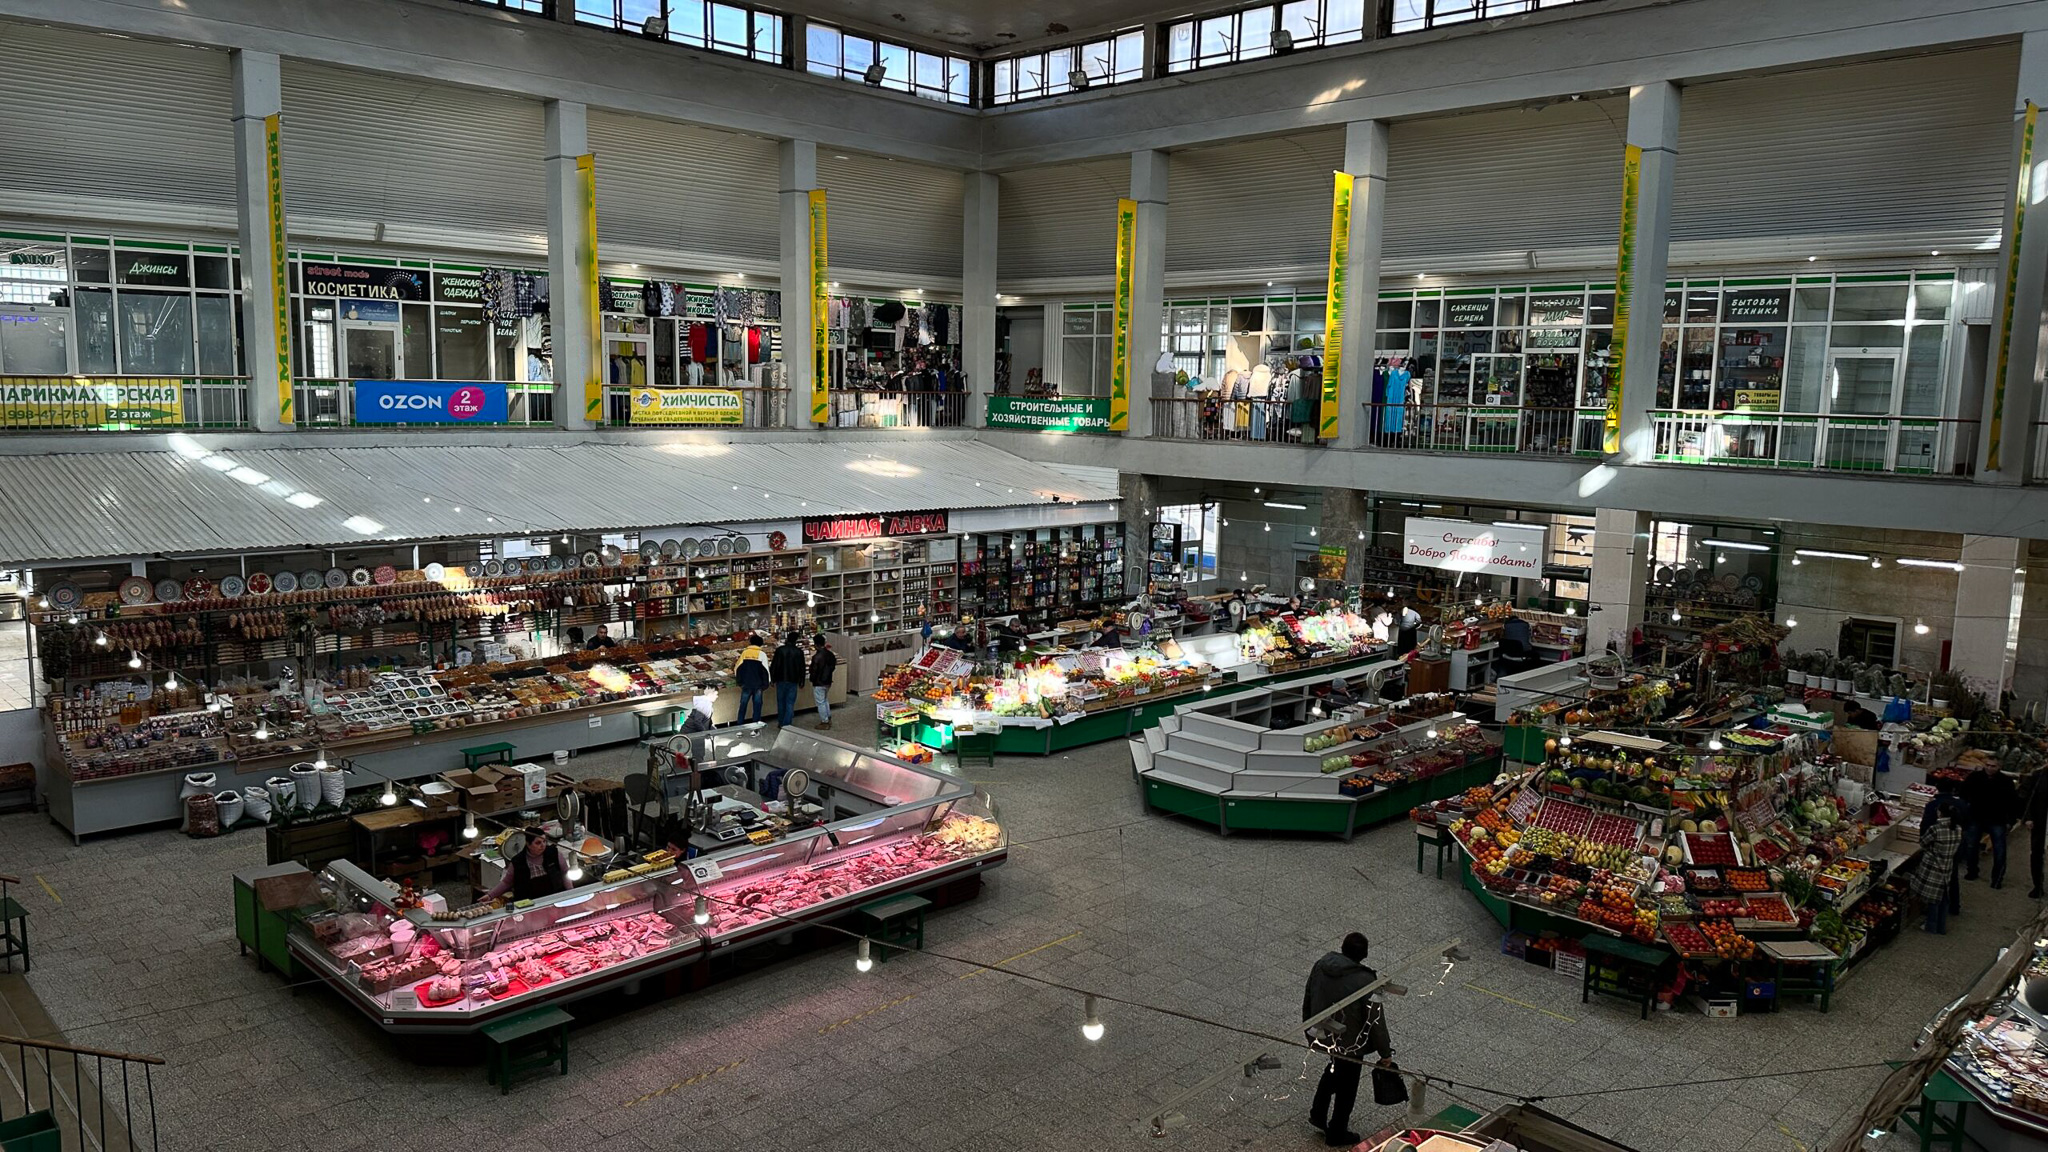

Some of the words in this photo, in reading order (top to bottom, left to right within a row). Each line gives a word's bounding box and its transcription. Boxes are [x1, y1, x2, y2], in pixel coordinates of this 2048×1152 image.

[268, 131, 289, 382] Мальцевский
[129, 262, 178, 275] Джинсы
[441, 277, 481, 287] ЖЕНСКАЯ
[308, 281, 399, 299] КОСМЕТИКА
[444, 288, 479, 298] ОДЕЖДА
[614, 300, 635, 308] БЕЛЬЕ
[686, 295, 714, 303] ЖИНСЫ
[1731, 298, 1780, 306] БЫТОВАЯ
[1451, 304, 1489, 312] САЖЕНЦЫ
[1731, 307, 1778, 315] ТЕХНИКА
[1542, 310, 1569, 322] МИР
[496, 328, 517, 336] БЕЛЬЕ
[379, 395, 442, 409] OZON
[461, 391, 471, 404] 2
[661, 395, 739, 407] ХИМЧИСТКА
[1010, 401, 1083, 413] СТРОИТЕЛЬНЫЕ
[1086, 404, 1093, 413] И
[109, 410, 117, 418] 2
[121, 410, 152, 419] этаж
[992, 413, 1071, 426] ХОЗЯЙСТВЕННЫЕ
[805, 516, 882, 540] ЧАЙНАЯ
[889, 513, 946, 534] ЛАВКА
[1442, 532, 1500, 547] Спасибо!
[1410, 545, 1446, 559] Добро
[1450, 549, 1537, 568] Пожаловать!
